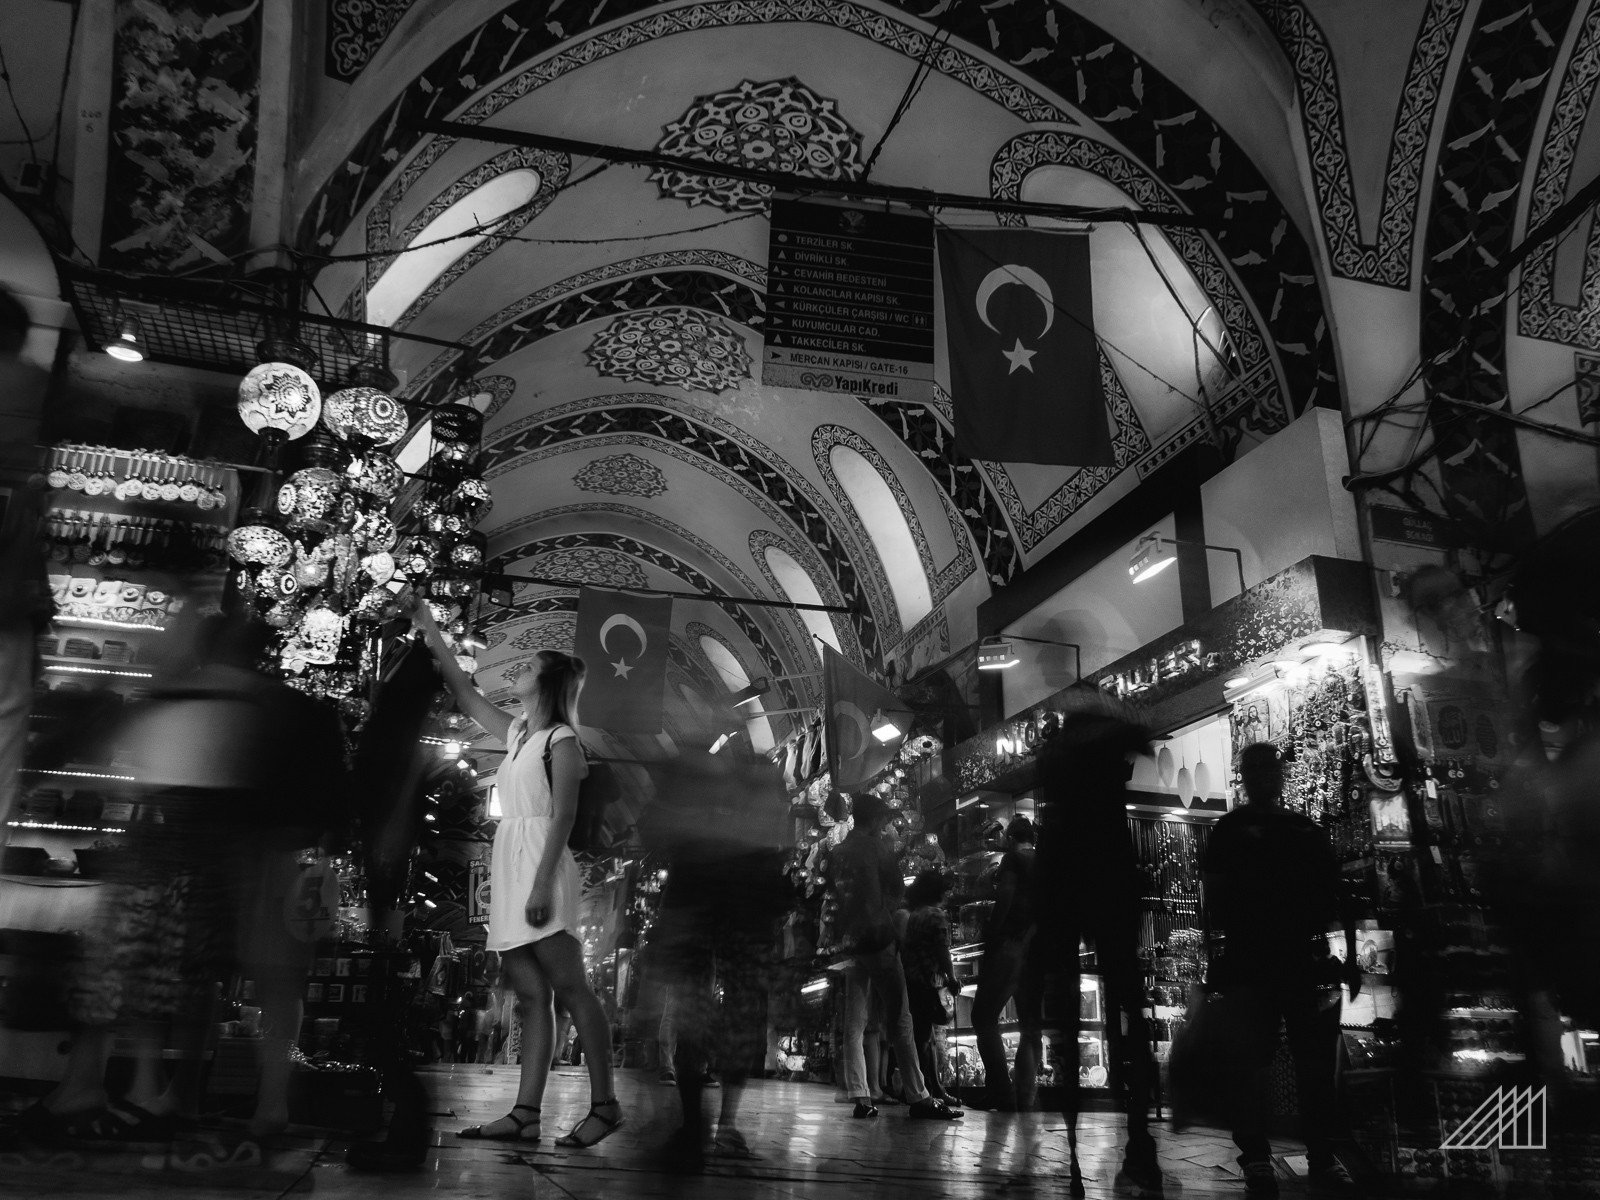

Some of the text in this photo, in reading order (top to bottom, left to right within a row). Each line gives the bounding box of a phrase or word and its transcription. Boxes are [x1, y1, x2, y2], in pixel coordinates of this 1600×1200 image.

[796, 234, 838, 249] TERZİLER
[795, 251, 833, 264] DİVRİKLİ
[794, 268, 887, 287] CEVAHİR BEDESTENİ
[793, 285, 852, 300] KOLANCILAR
[854, 291, 884, 303] KAPISI
[851, 309, 888, 321] ÇARŞISI
[894, 312, 909, 323] WC
[791, 318, 880, 337] KUYUMCULAR CAD.
[791, 334, 850, 350] TAKKECİLER
[790, 353, 830, 365] MERCAN
[832, 358, 863, 370] KAPISI
[870, 363, 909, 375] GATE-16
